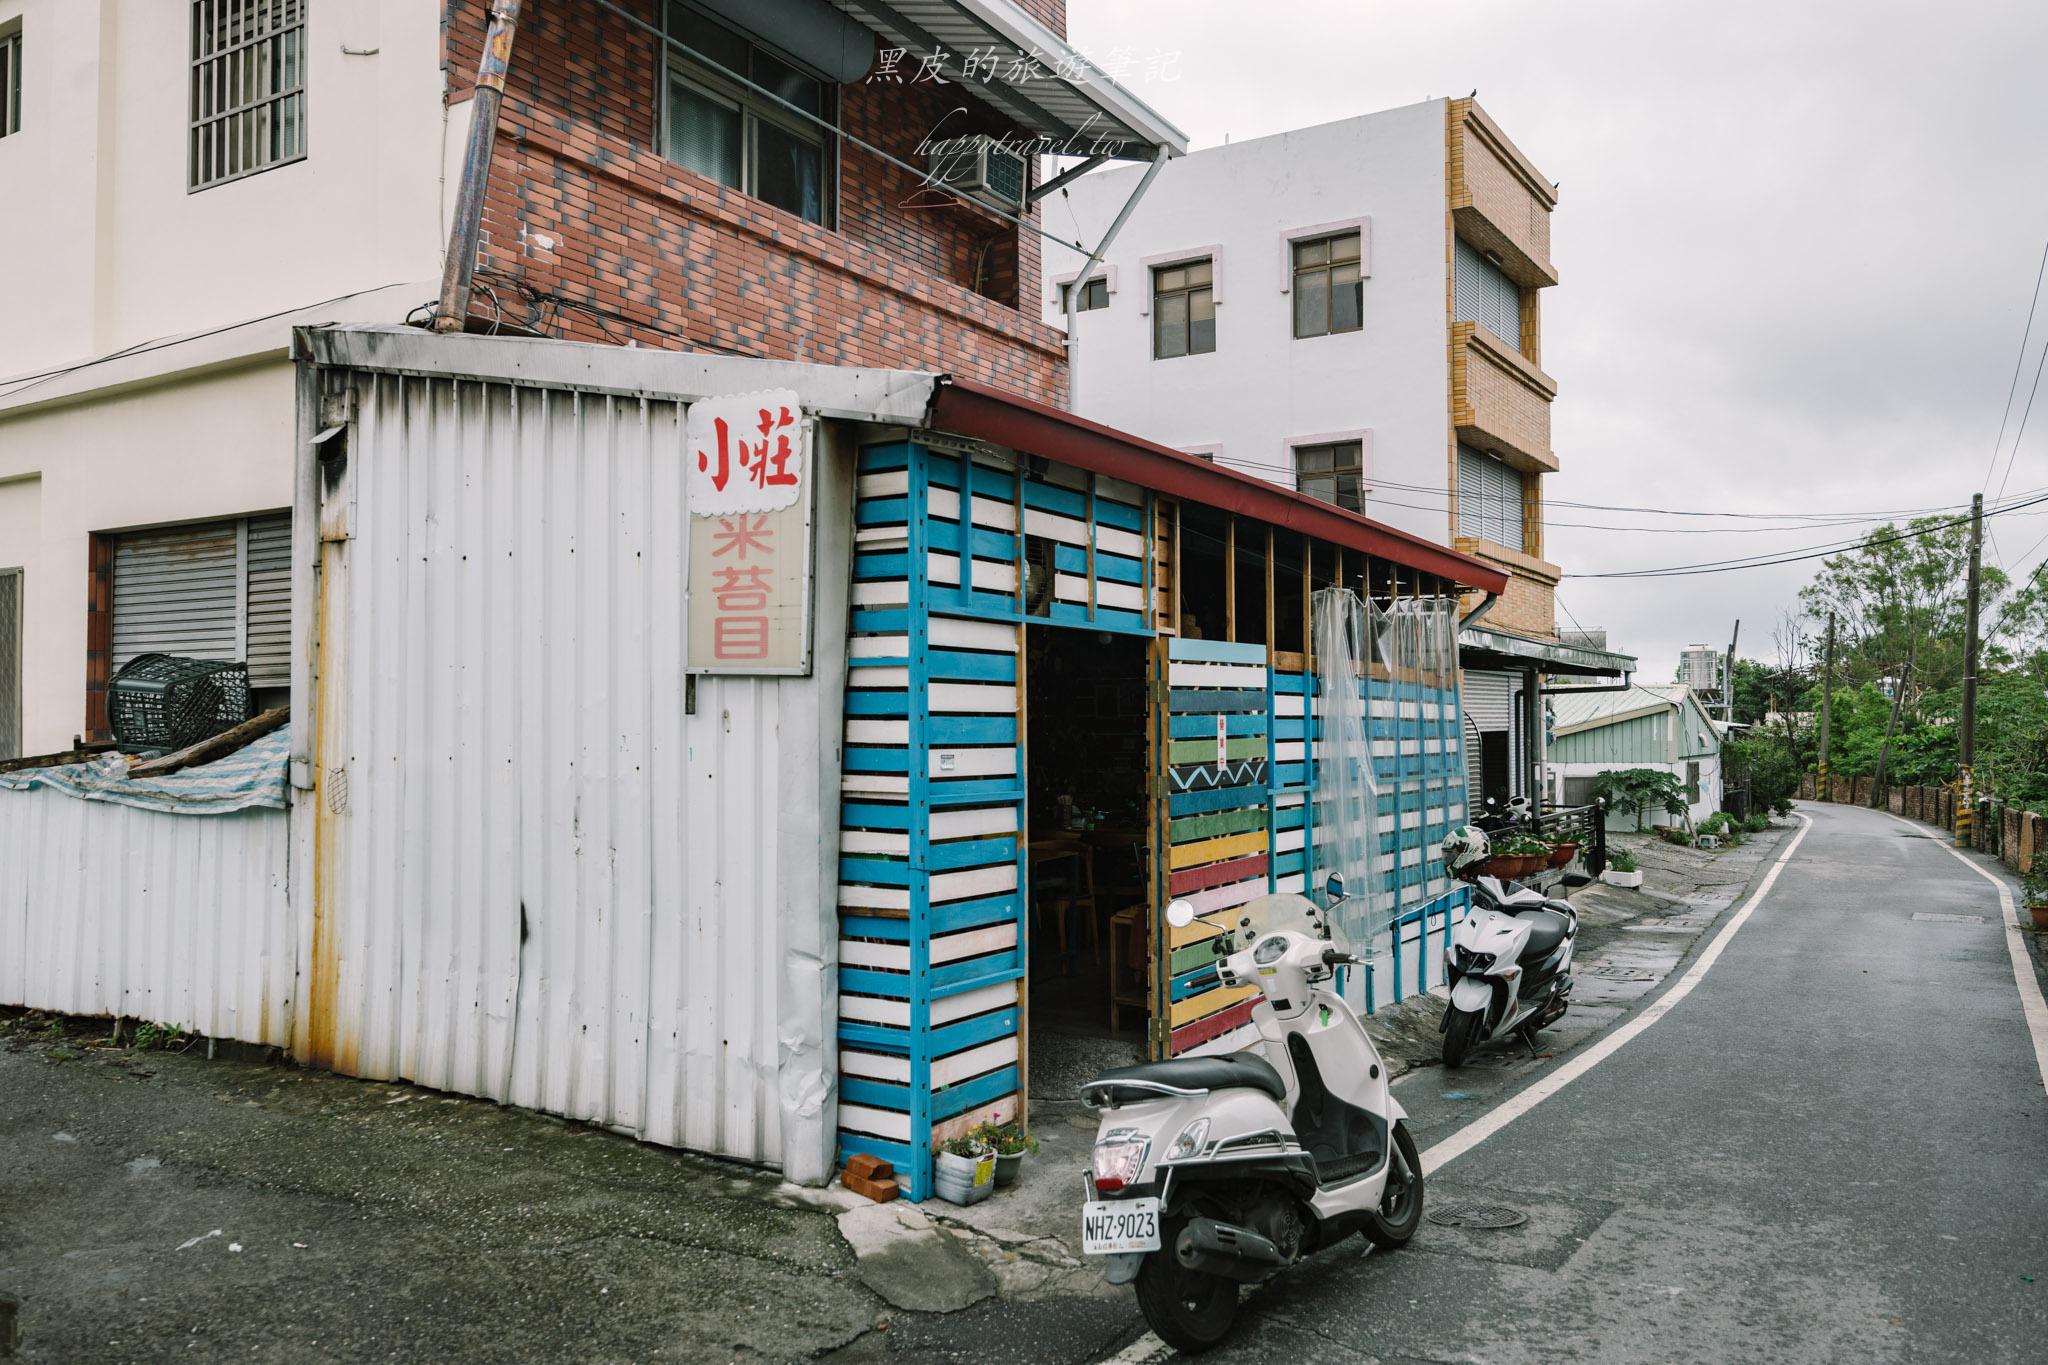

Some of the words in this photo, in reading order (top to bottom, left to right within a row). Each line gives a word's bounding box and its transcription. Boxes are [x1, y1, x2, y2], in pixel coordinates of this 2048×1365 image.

[698, 406, 798, 492] 小莊
[711, 513, 775, 660] 米苔目
